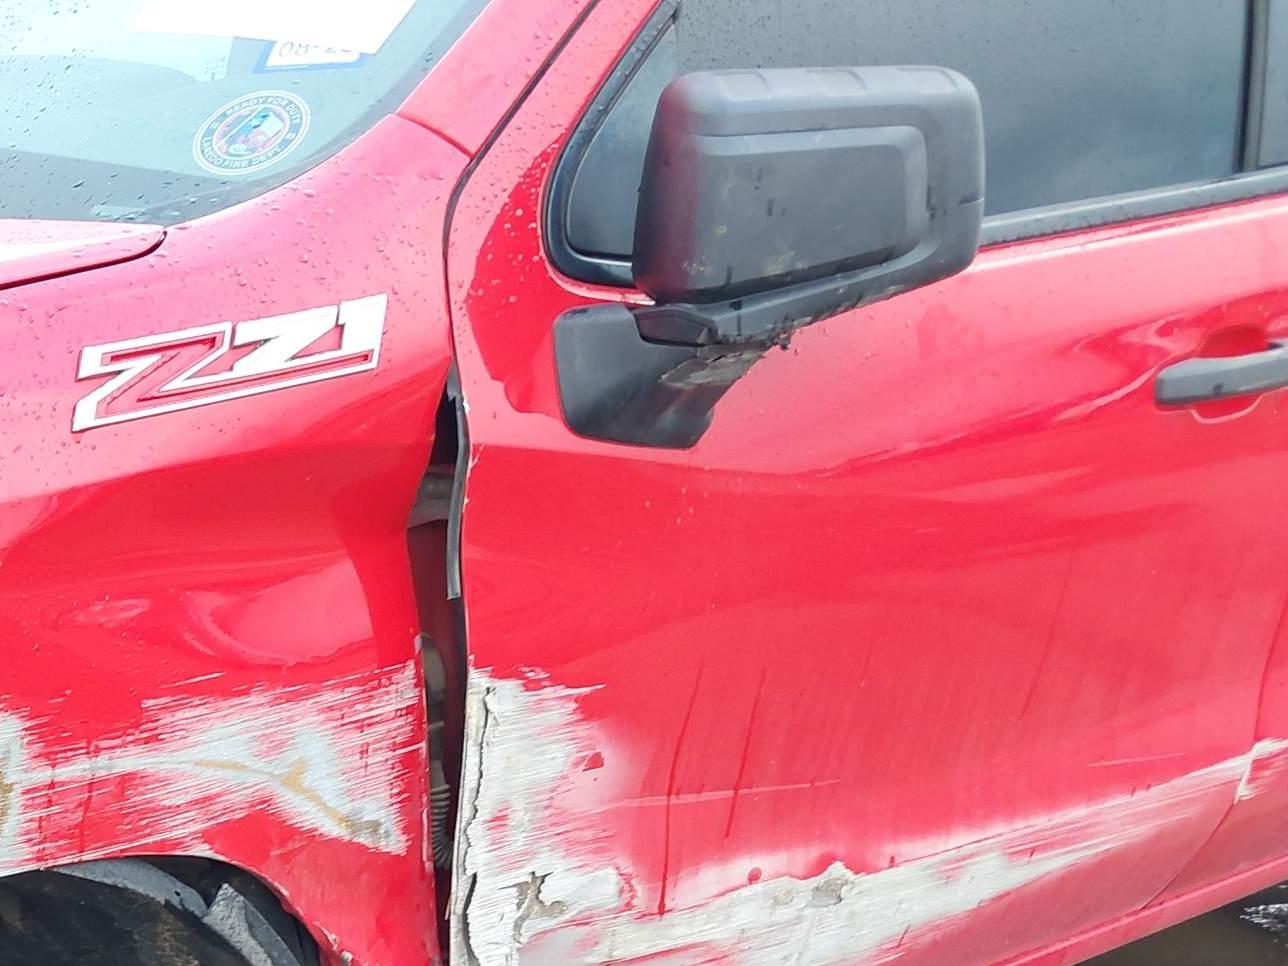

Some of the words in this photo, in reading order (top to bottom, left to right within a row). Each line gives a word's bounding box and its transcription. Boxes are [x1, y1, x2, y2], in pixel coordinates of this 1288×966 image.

[225, 97, 266, 116] READY
[267, 96, 289, 108] FOR
[286, 104, 301, 123] DUTY
[202, 136, 223, 165] LAREDO
[222, 160, 249, 168] FIRE
[72, 293, 388, 433] Z71
